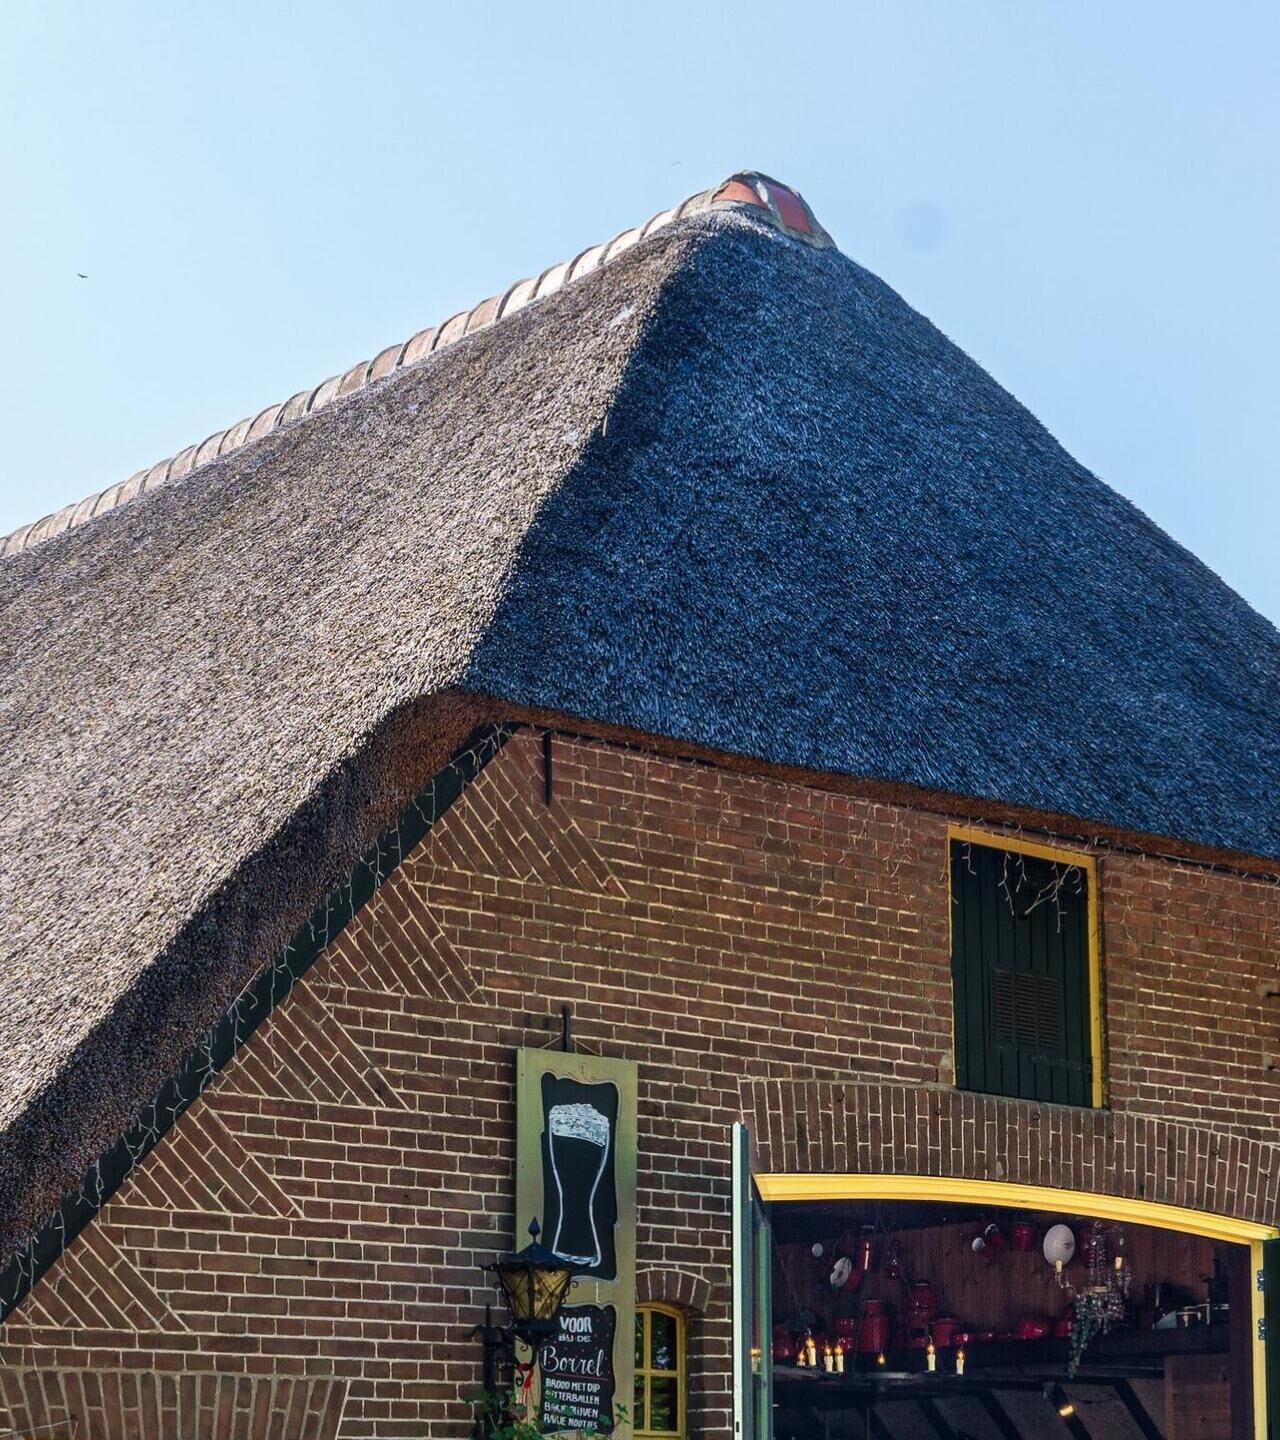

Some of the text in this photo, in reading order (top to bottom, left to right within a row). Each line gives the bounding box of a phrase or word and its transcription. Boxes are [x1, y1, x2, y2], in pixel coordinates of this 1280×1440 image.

[559, 1316, 593, 1333] VOOR
[577, 1335, 592, 1343] DE
[540, 1345, 605, 1377] Borrel
[545, 1378, 601, 1393] BROOD MET DIP
[544, 1390, 600, 1405] BTTERBALLEN
